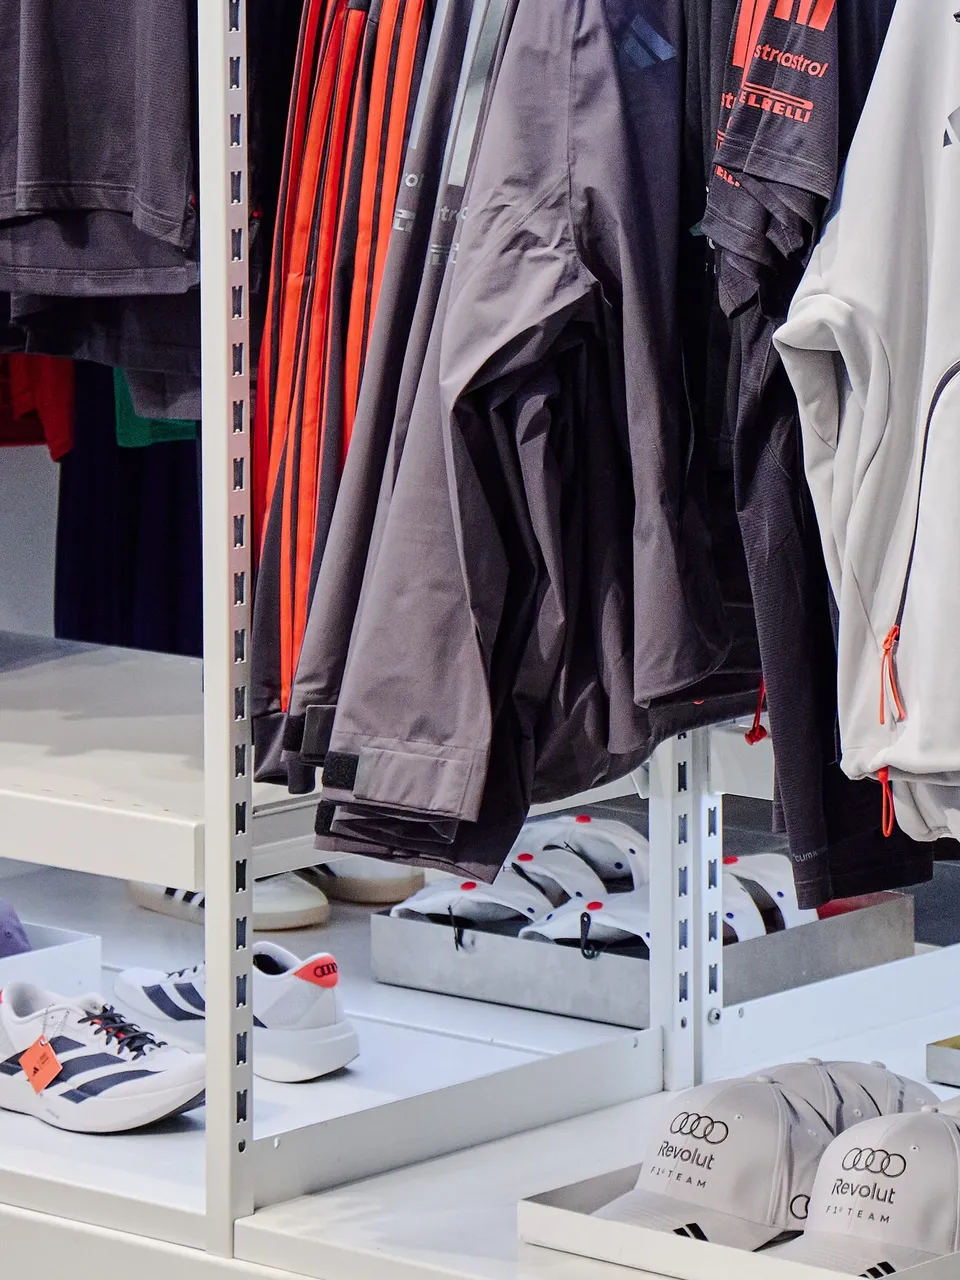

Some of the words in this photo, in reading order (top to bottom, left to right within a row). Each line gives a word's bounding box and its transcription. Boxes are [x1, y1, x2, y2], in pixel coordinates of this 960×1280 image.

[781, 52, 829, 78] astrol
[657, 1140, 715, 1170] Revolut
[668, 1170, 706, 1188] TEAM
[831, 1178, 896, 1204] Revolut
[848, 1208, 890, 1223] TEAM
